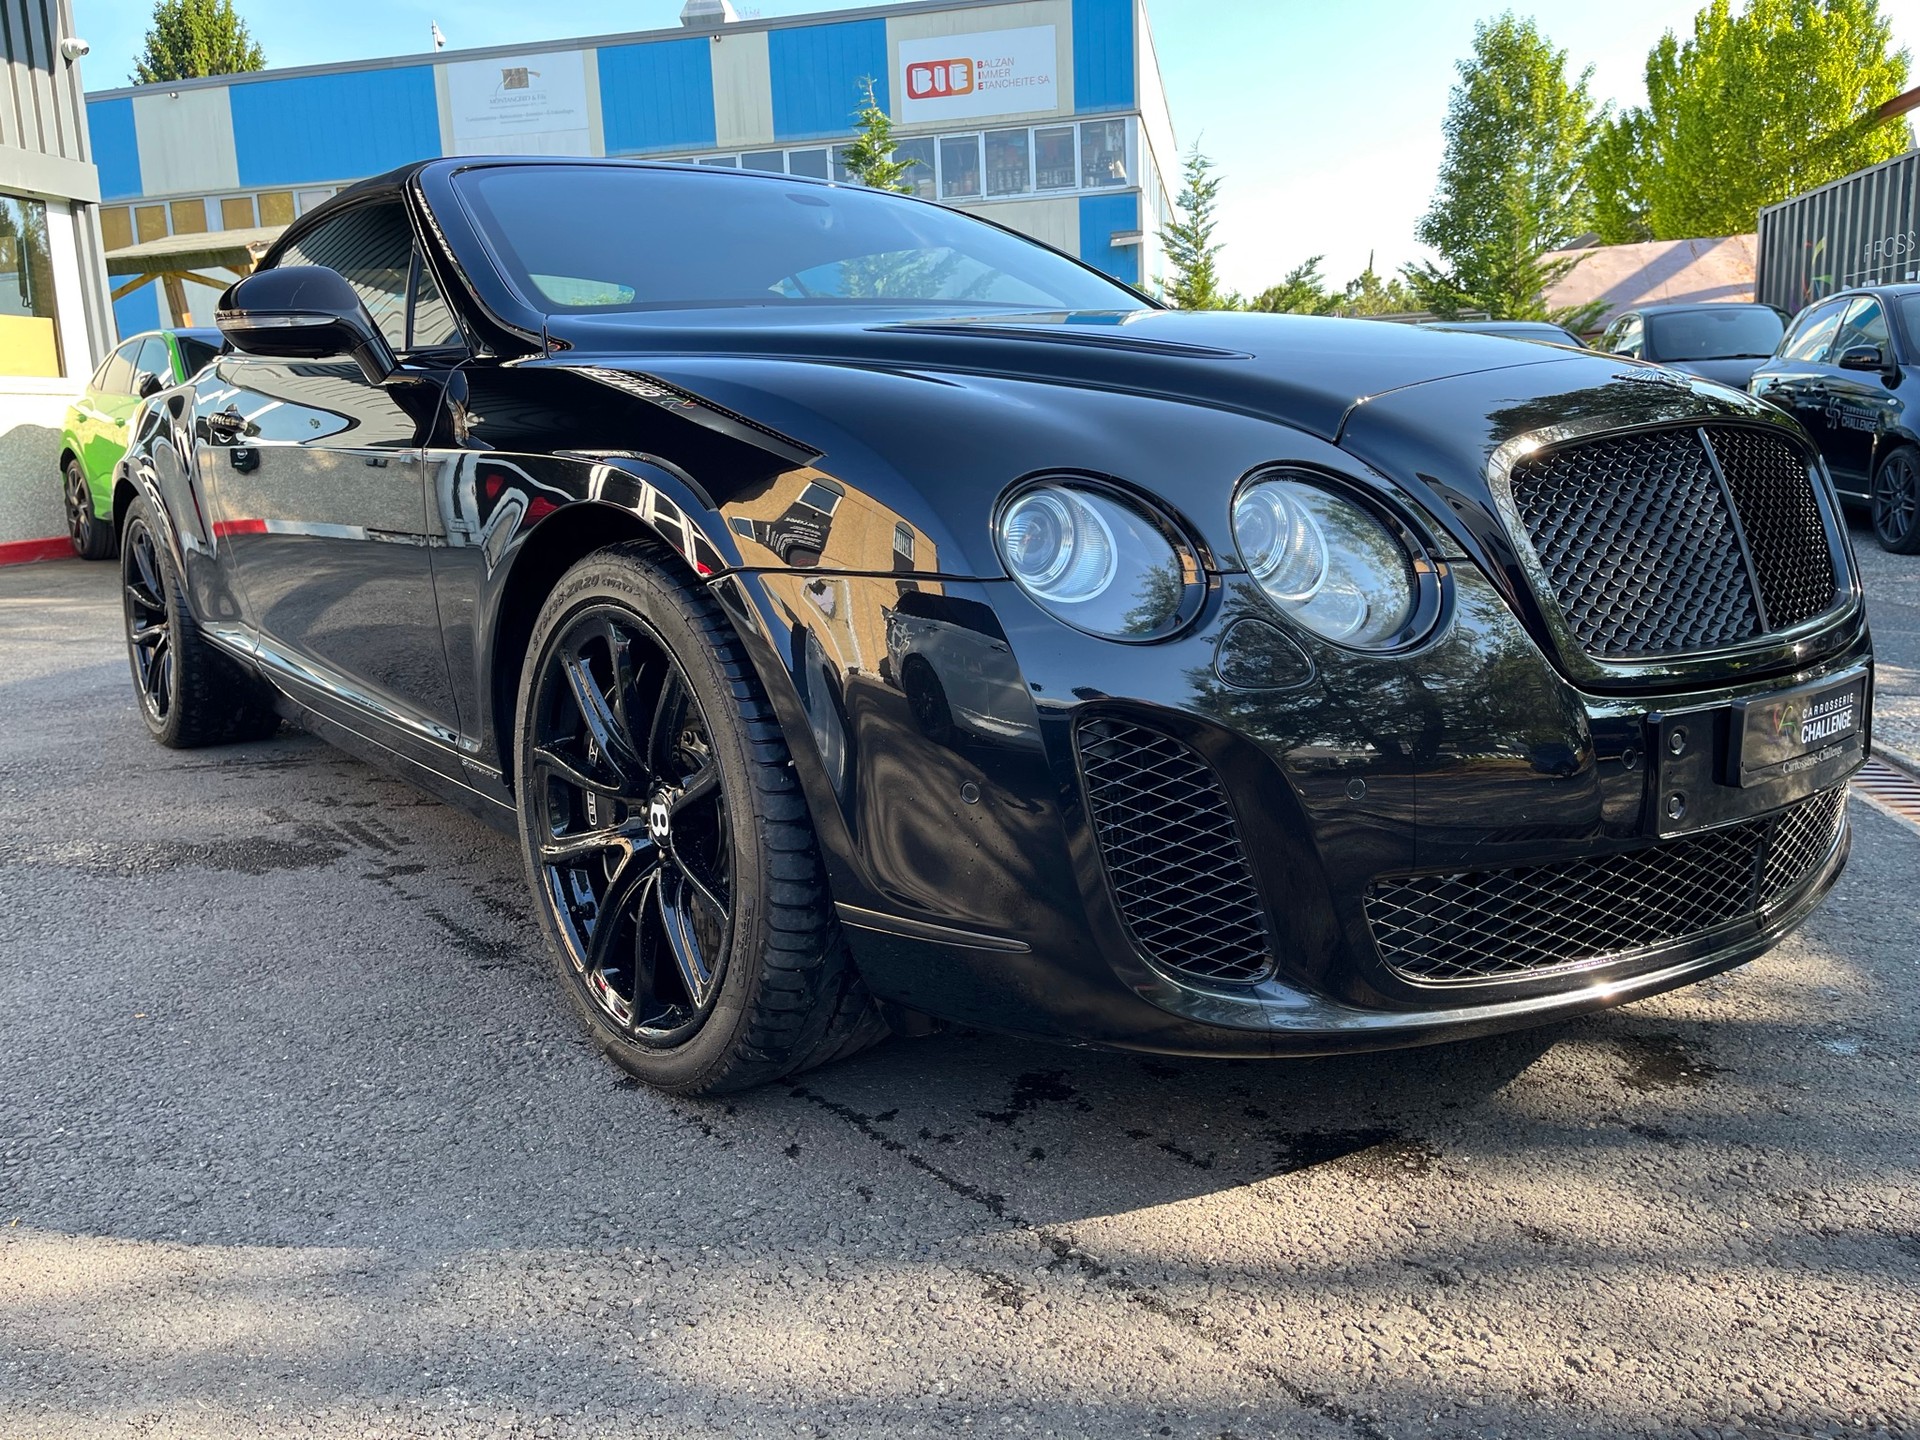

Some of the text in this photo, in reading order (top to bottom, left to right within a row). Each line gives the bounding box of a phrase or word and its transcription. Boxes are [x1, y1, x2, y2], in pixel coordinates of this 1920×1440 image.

[976, 57, 1015, 69] BALZAN
[978, 68, 1011, 79] IMMER
[977, 75, 1050, 91] ETANCHEITE SA
[1841, 416, 1877, 433] CHALLENGE
[1802, 692, 1854, 719] CARROSSERIE
[1801, 709, 1853, 744] CHALLENGE
